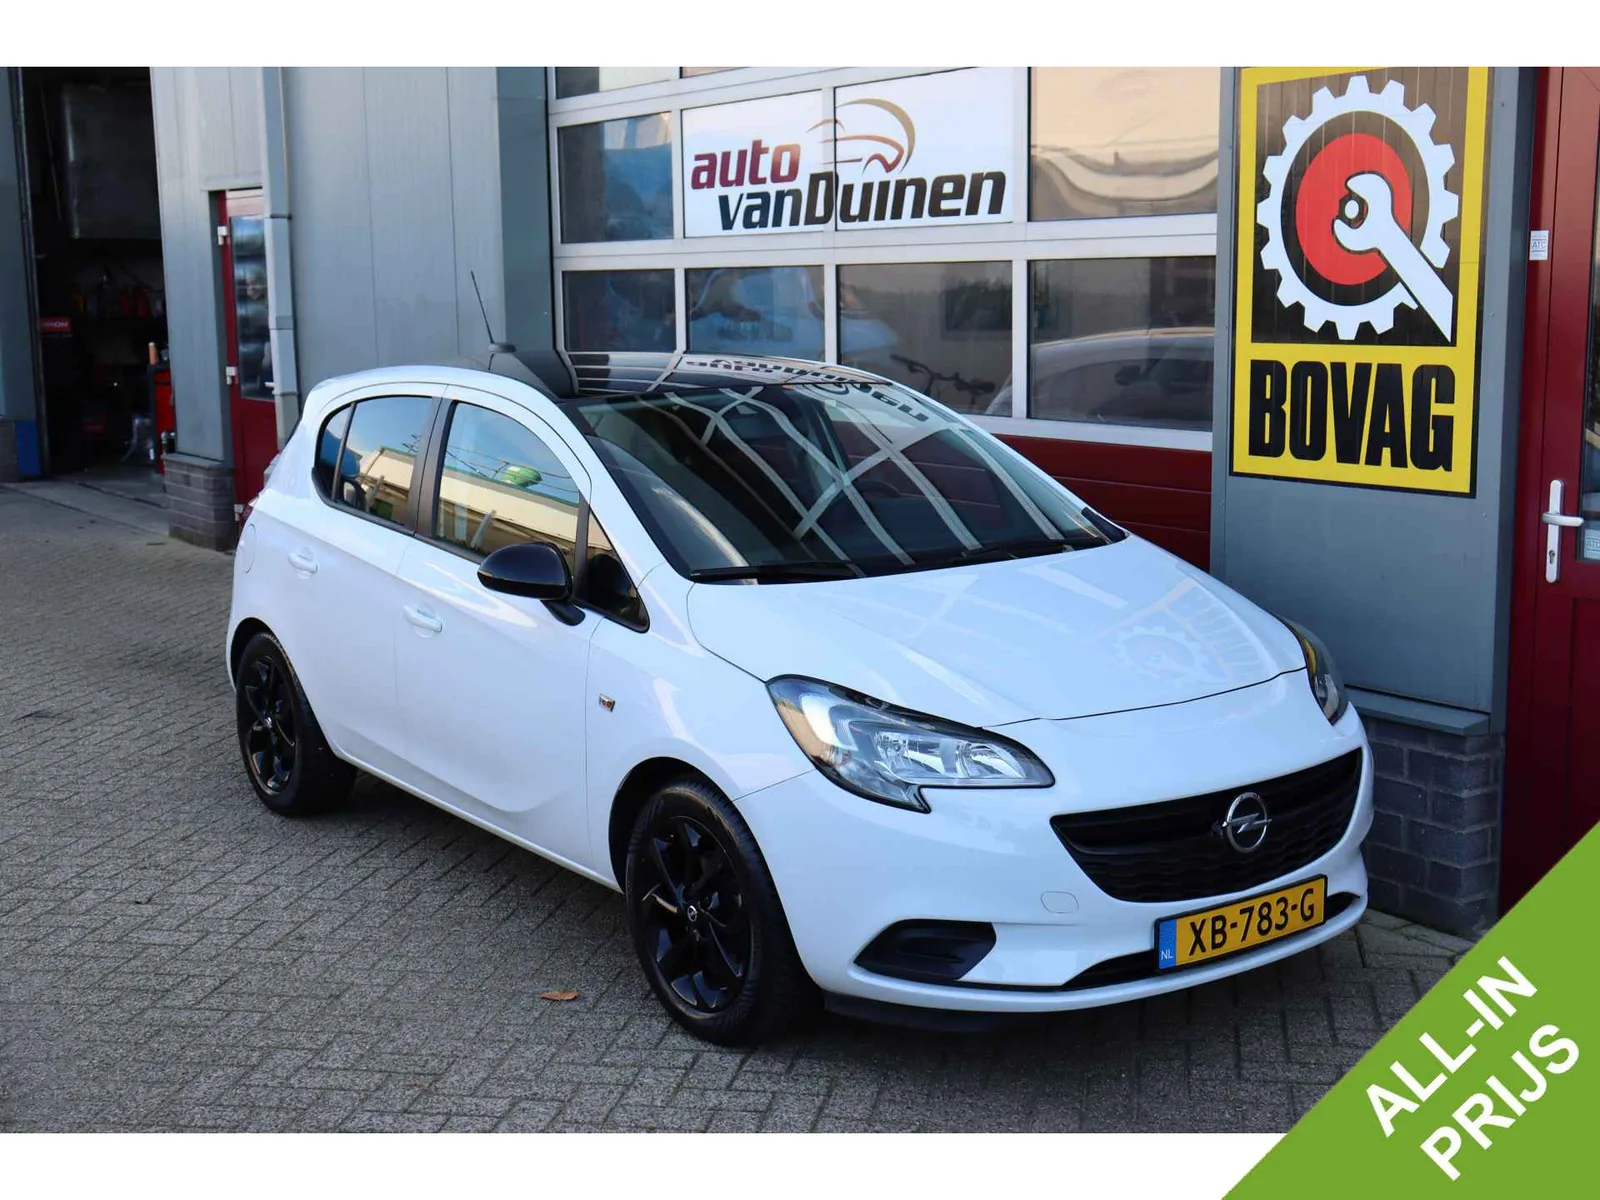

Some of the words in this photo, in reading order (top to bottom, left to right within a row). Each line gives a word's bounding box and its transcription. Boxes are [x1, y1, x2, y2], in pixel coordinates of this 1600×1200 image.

[691, 139, 801, 190] auto
[1248, 360, 1456, 472] BOVAG
[1189, 888, 1315, 956] XB-783-G
[1161, 951, 1174, 960] NL
